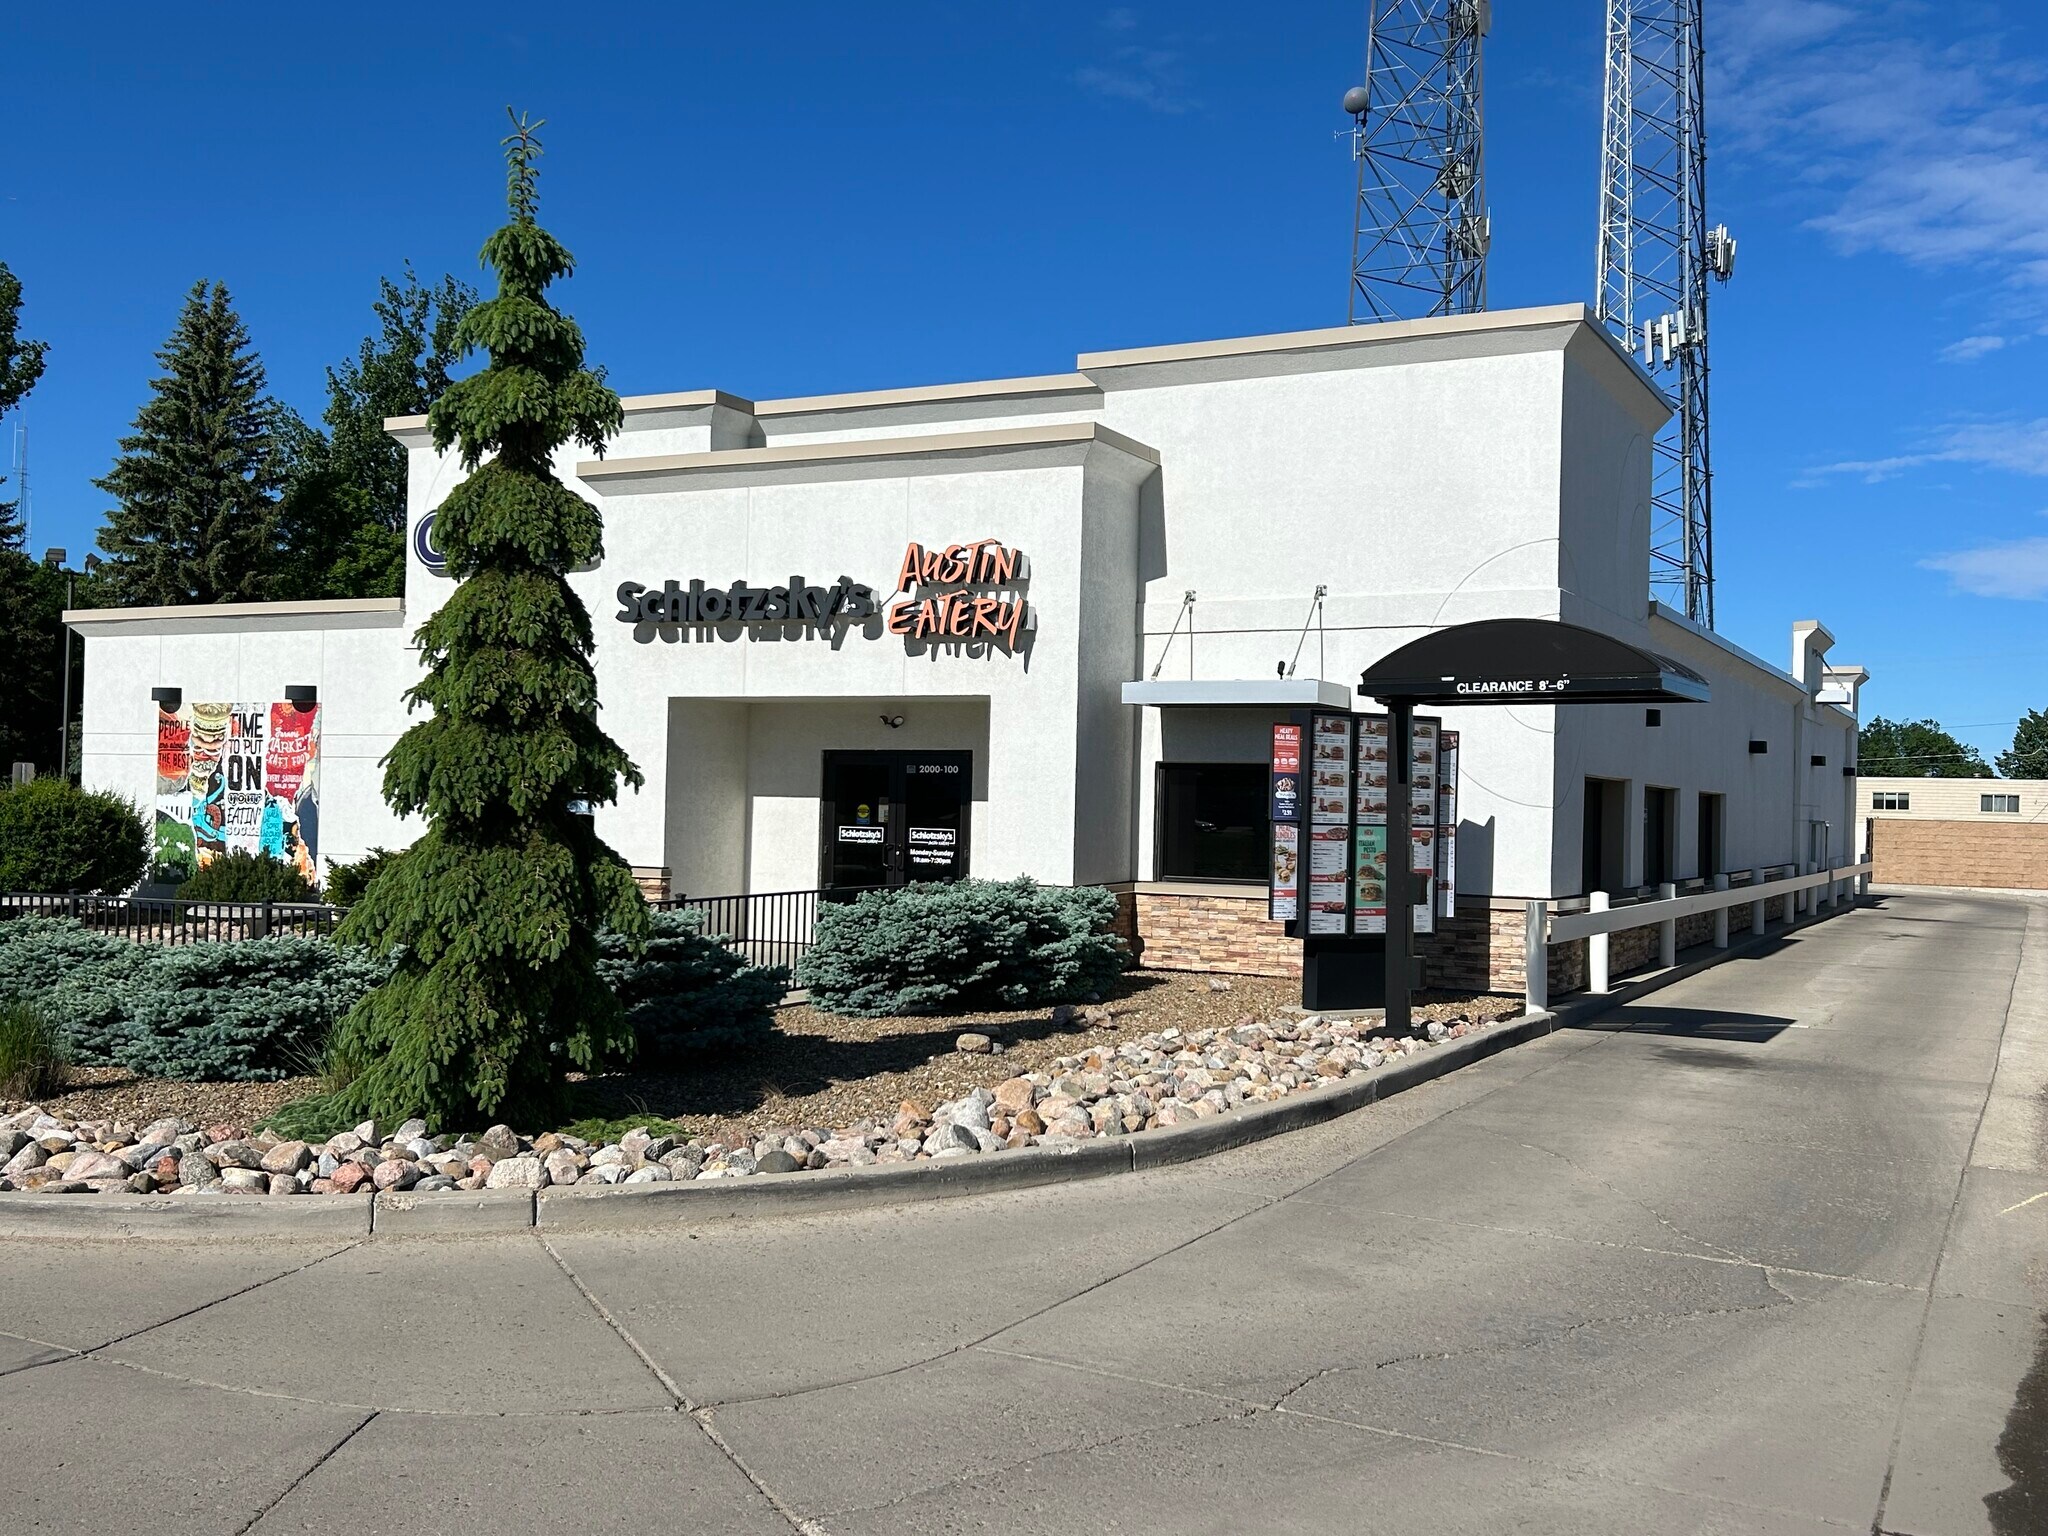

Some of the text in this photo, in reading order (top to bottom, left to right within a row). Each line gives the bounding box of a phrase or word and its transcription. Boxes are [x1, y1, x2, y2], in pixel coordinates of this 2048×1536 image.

[898, 538, 1020, 592] AUSTIN
[615, 576, 873, 628] Schlotzsky's
[888, 588, 1023, 649] EATERY
[1457, 681, 1533, 694] CLEARANCE
[158, 720, 191, 740] PEOPLE
[230, 713, 264, 738] TIME
[228, 739, 263, 754] TO PUT
[158, 753, 171, 764] THE
[172, 753, 190, 770] BEST
[919, 765, 959, 774] 2000-100
[228, 755, 262, 791] ON
[227, 806, 262, 826] EATIN'
[841, 829, 881, 839] Schlotzsky's
[911, 831, 953, 841] Schlotzsky's
